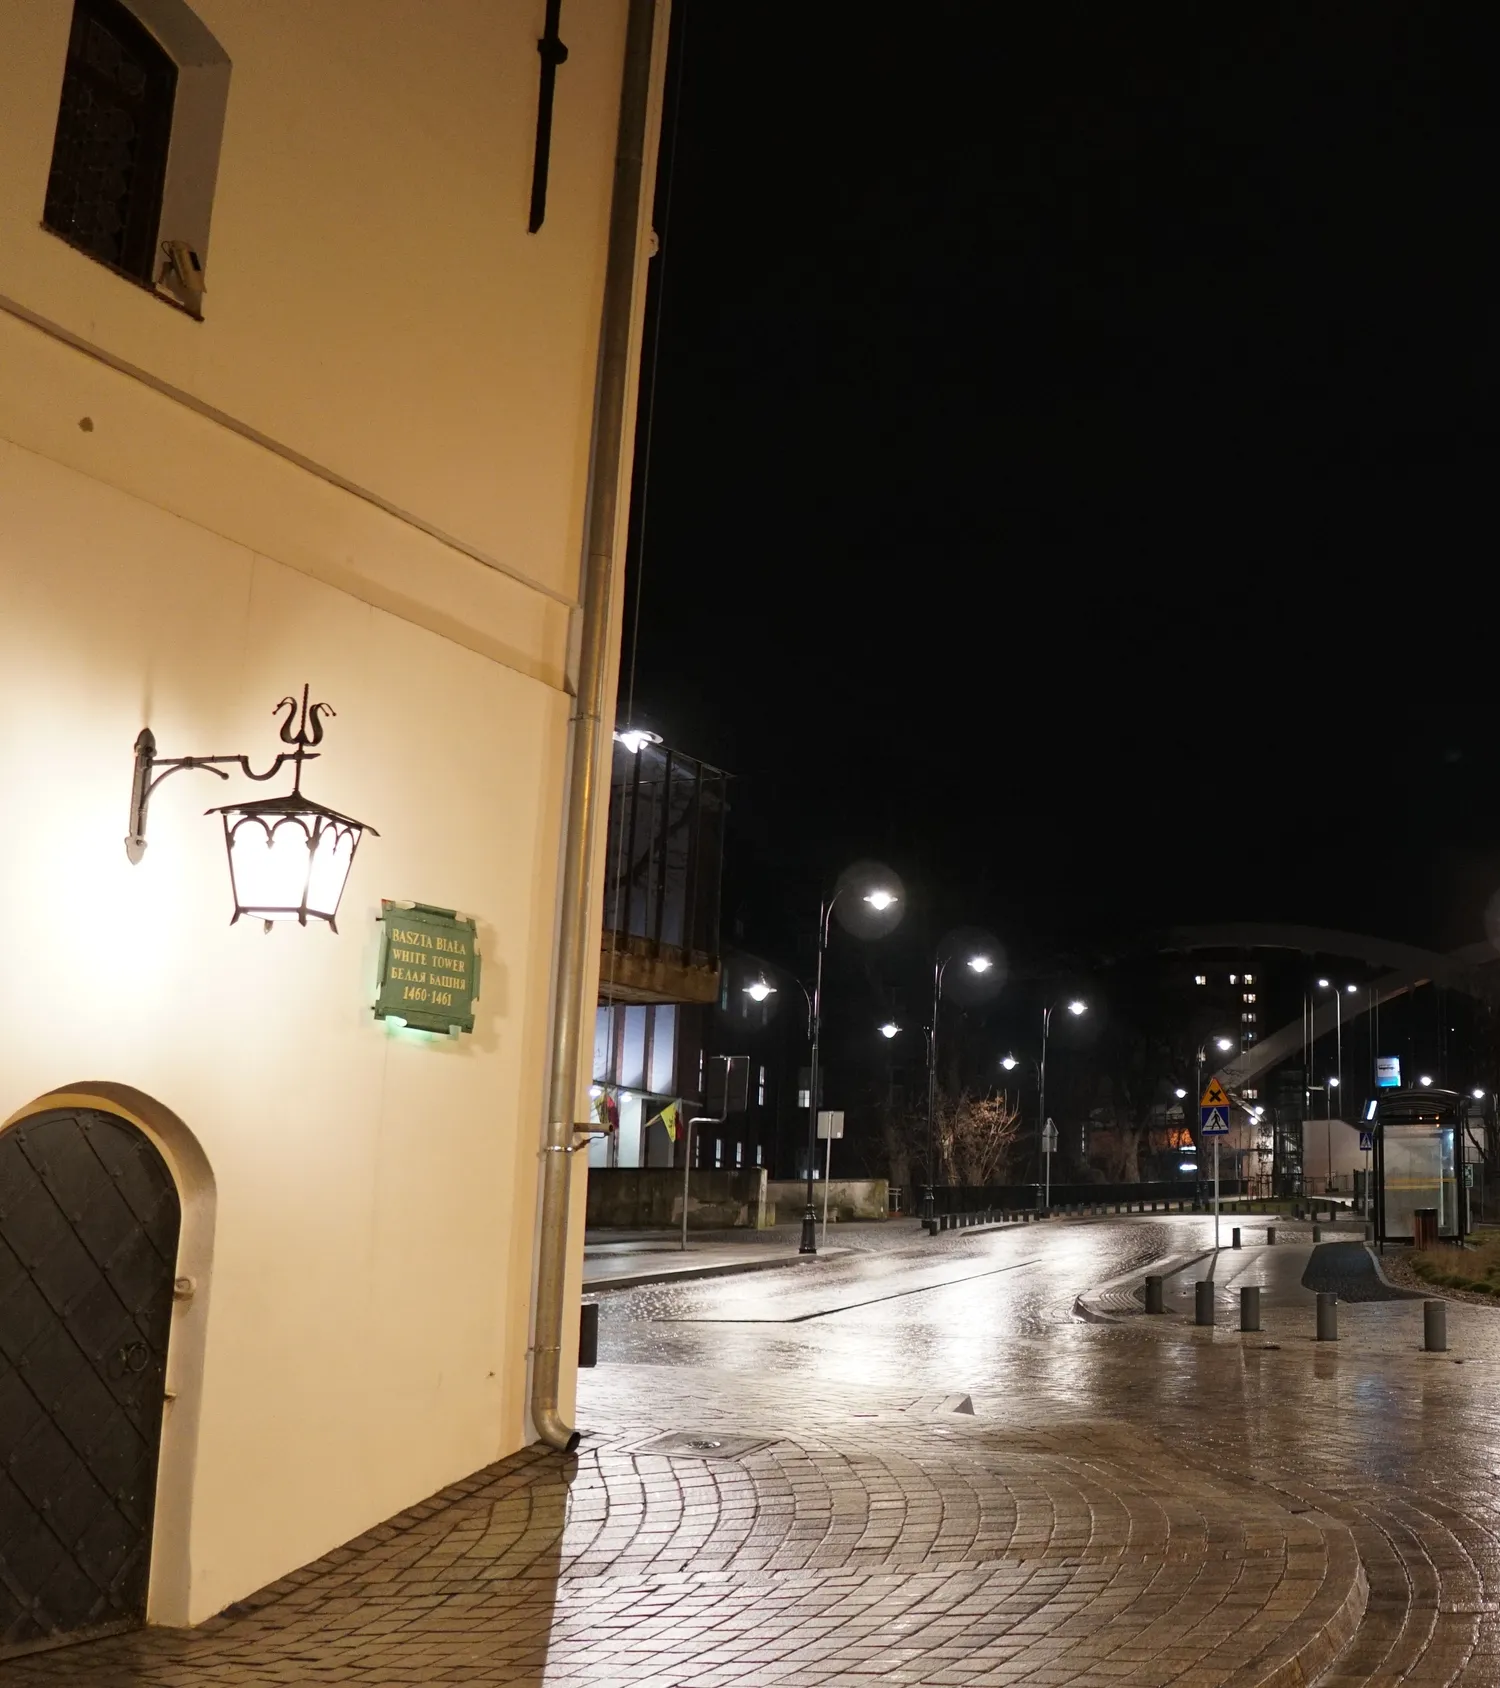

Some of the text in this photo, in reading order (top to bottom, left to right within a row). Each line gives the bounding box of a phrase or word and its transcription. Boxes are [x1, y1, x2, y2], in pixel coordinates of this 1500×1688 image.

[392, 928, 466, 955] BASZTA BIAŁA
[392, 948, 465, 972] WHITE TOWER
[391, 966, 466, 990] БЕЛАЯ БАШНЯ
